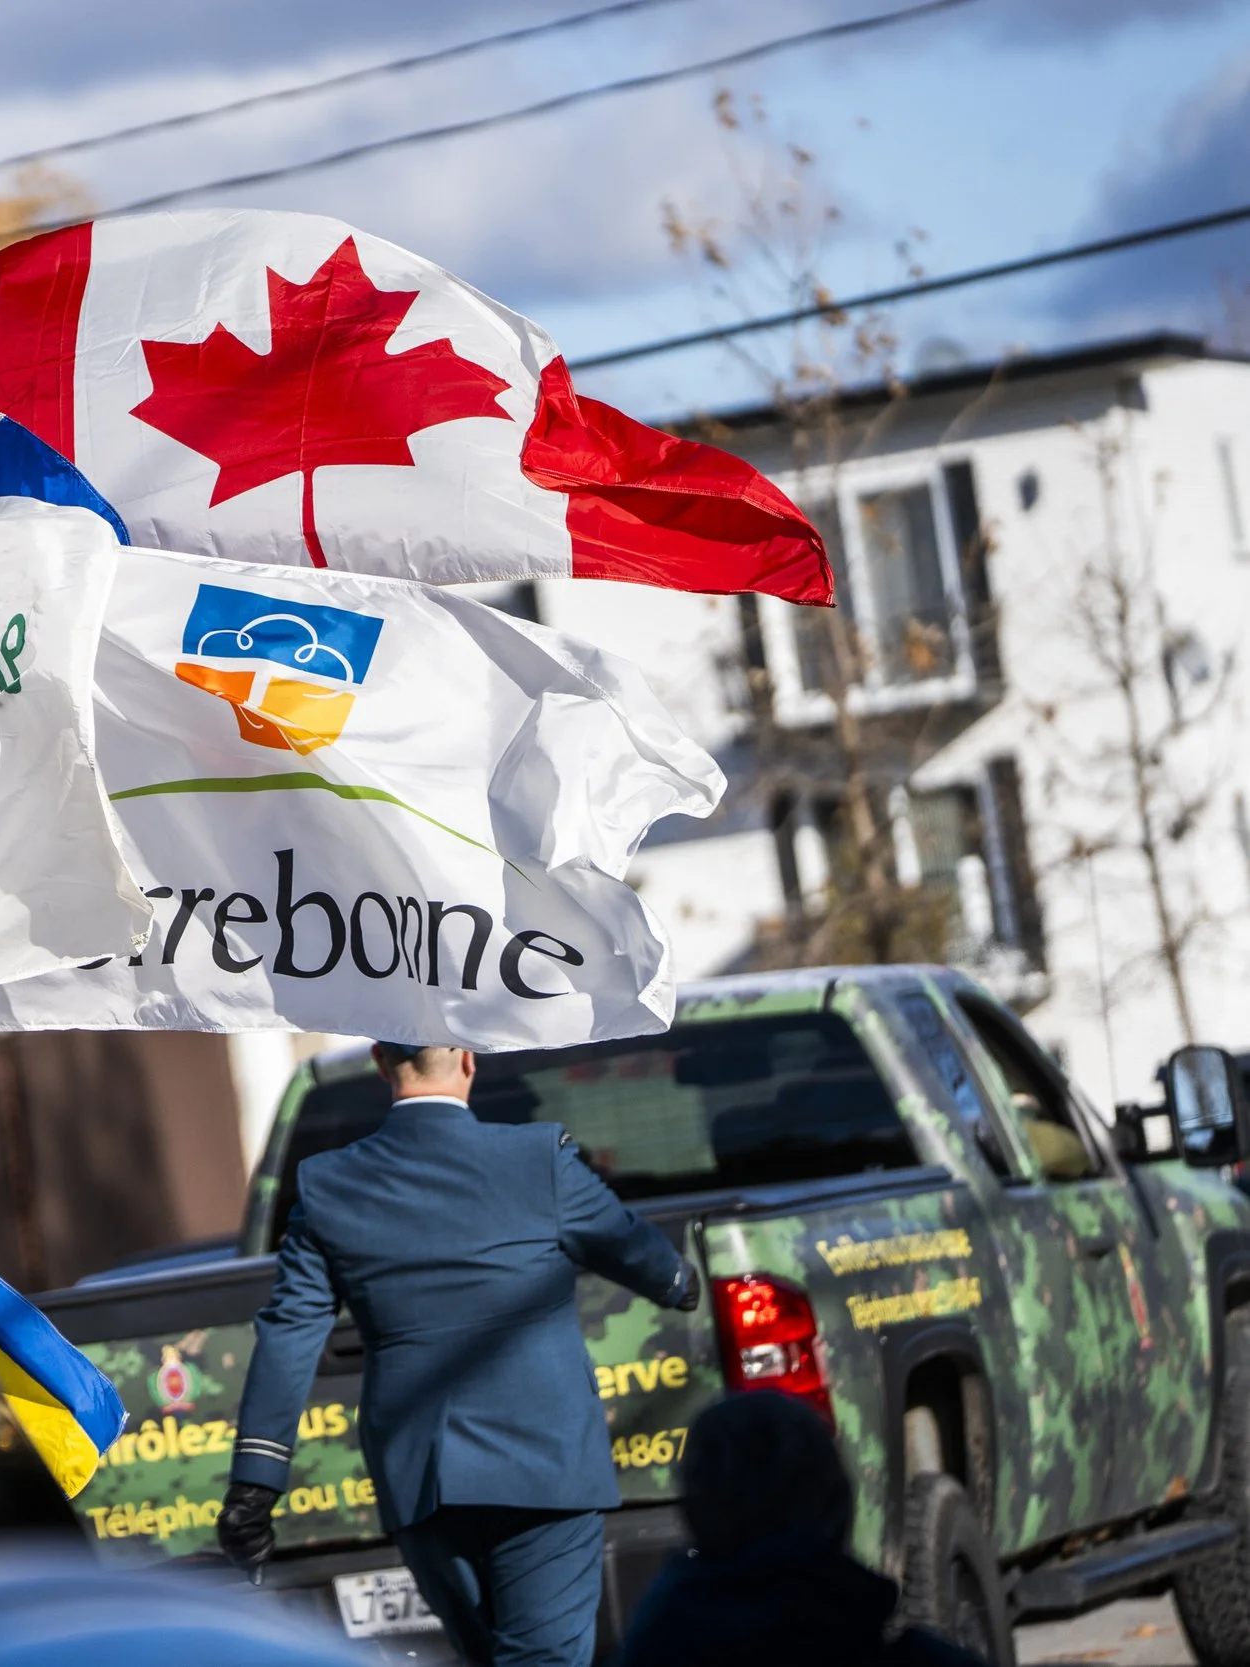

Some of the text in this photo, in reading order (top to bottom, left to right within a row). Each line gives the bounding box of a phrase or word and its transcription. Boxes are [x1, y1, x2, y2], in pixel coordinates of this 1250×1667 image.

[76, 848, 584, 1000] rebonne
[594, 1355, 688, 1400] erve
[289, 1483, 338, 1515] ou
